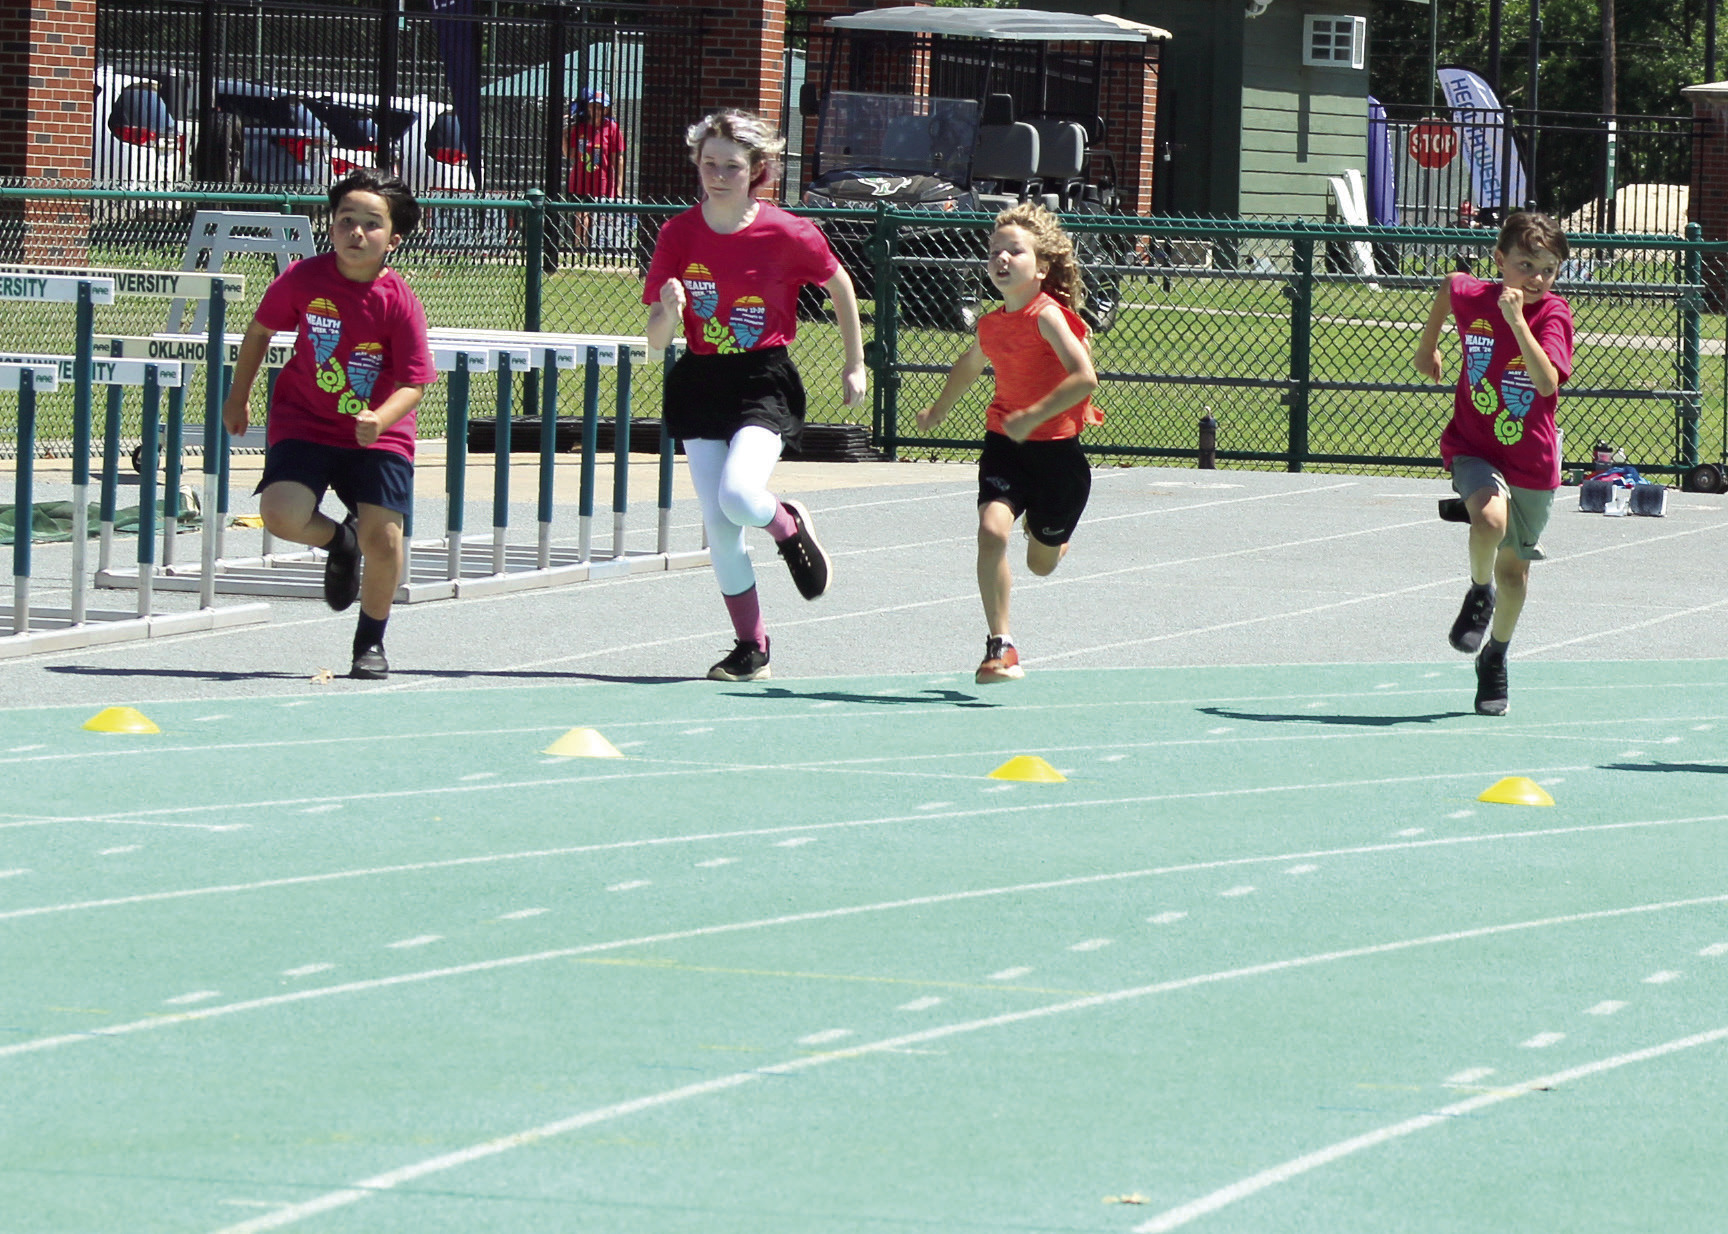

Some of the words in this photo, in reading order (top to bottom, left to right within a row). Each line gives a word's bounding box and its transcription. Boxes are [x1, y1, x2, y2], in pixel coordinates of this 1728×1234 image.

[1411, 133, 1454, 153] STOP
[1450, 77, 1501, 202] HEATHWEEK
[0, 276, 48, 297] RSITY
[91, 269, 179, 293] IVERSITY
[682, 279, 716, 290] HEALTH
[305, 313, 341, 329] HEALTH
[1465, 334, 1495, 346] HEALTH
[149, 341, 226, 362] OKLAHO
[230, 345, 287, 364] BIST
